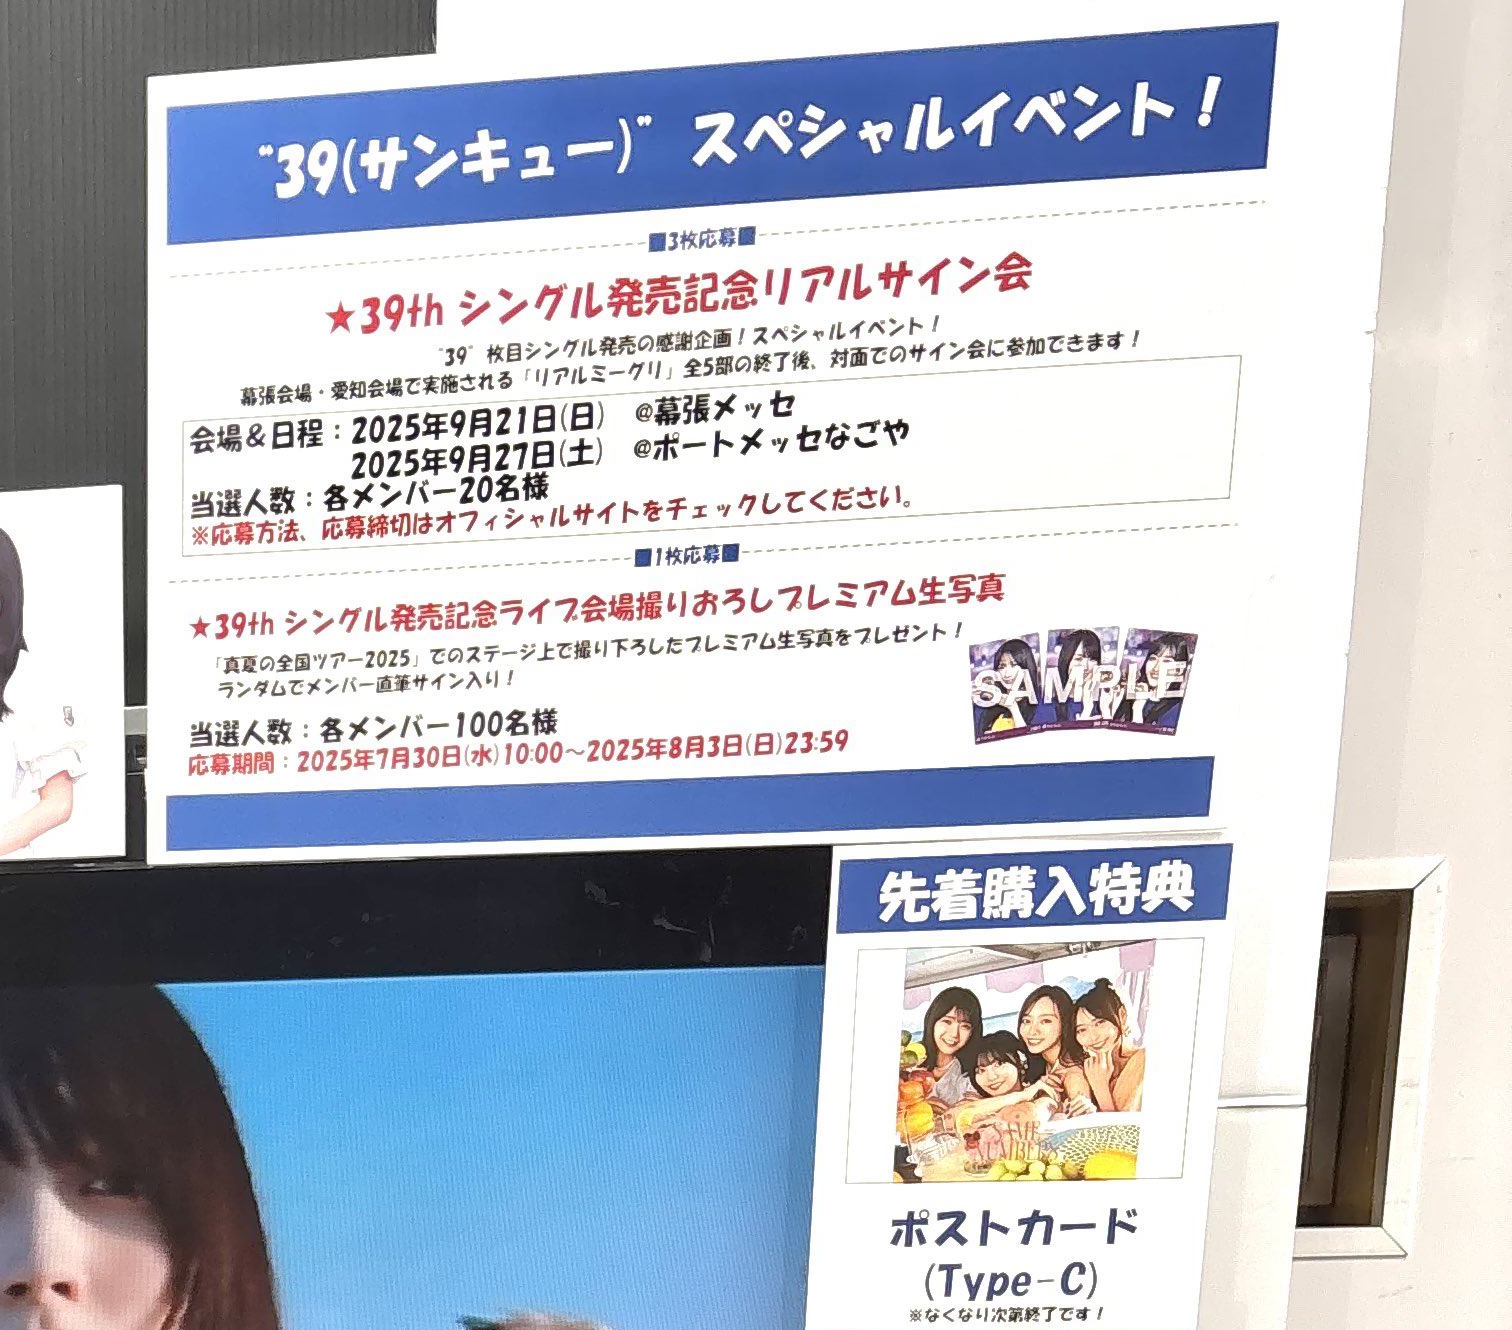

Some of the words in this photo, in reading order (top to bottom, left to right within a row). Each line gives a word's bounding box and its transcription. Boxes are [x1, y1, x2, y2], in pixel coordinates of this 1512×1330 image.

[691, 75, 1222, 168] スペシャルイベント！
[360, 292, 444, 335] 39th
[458, 251, 1033, 329] シングル発売記念リアルサイン会
[635, 390, 796, 426] @幕張メッセ
[351, 436, 604, 480] 2025年9月27日(土)
[633, 418, 911, 461] @ポートメッセなごや
[214, 613, 275, 640] 39th
[285, 572, 1007, 633] シングル発売記念ライブ会場撮りおろしプレミアム生写真
[972, 660, 1189, 708] SAMPLE
[878, 860, 1196, 923] 先着購入特典
[889, 1207, 1139, 1248] ポストカード
[924, 1260, 1099, 1300] (Type-C)
